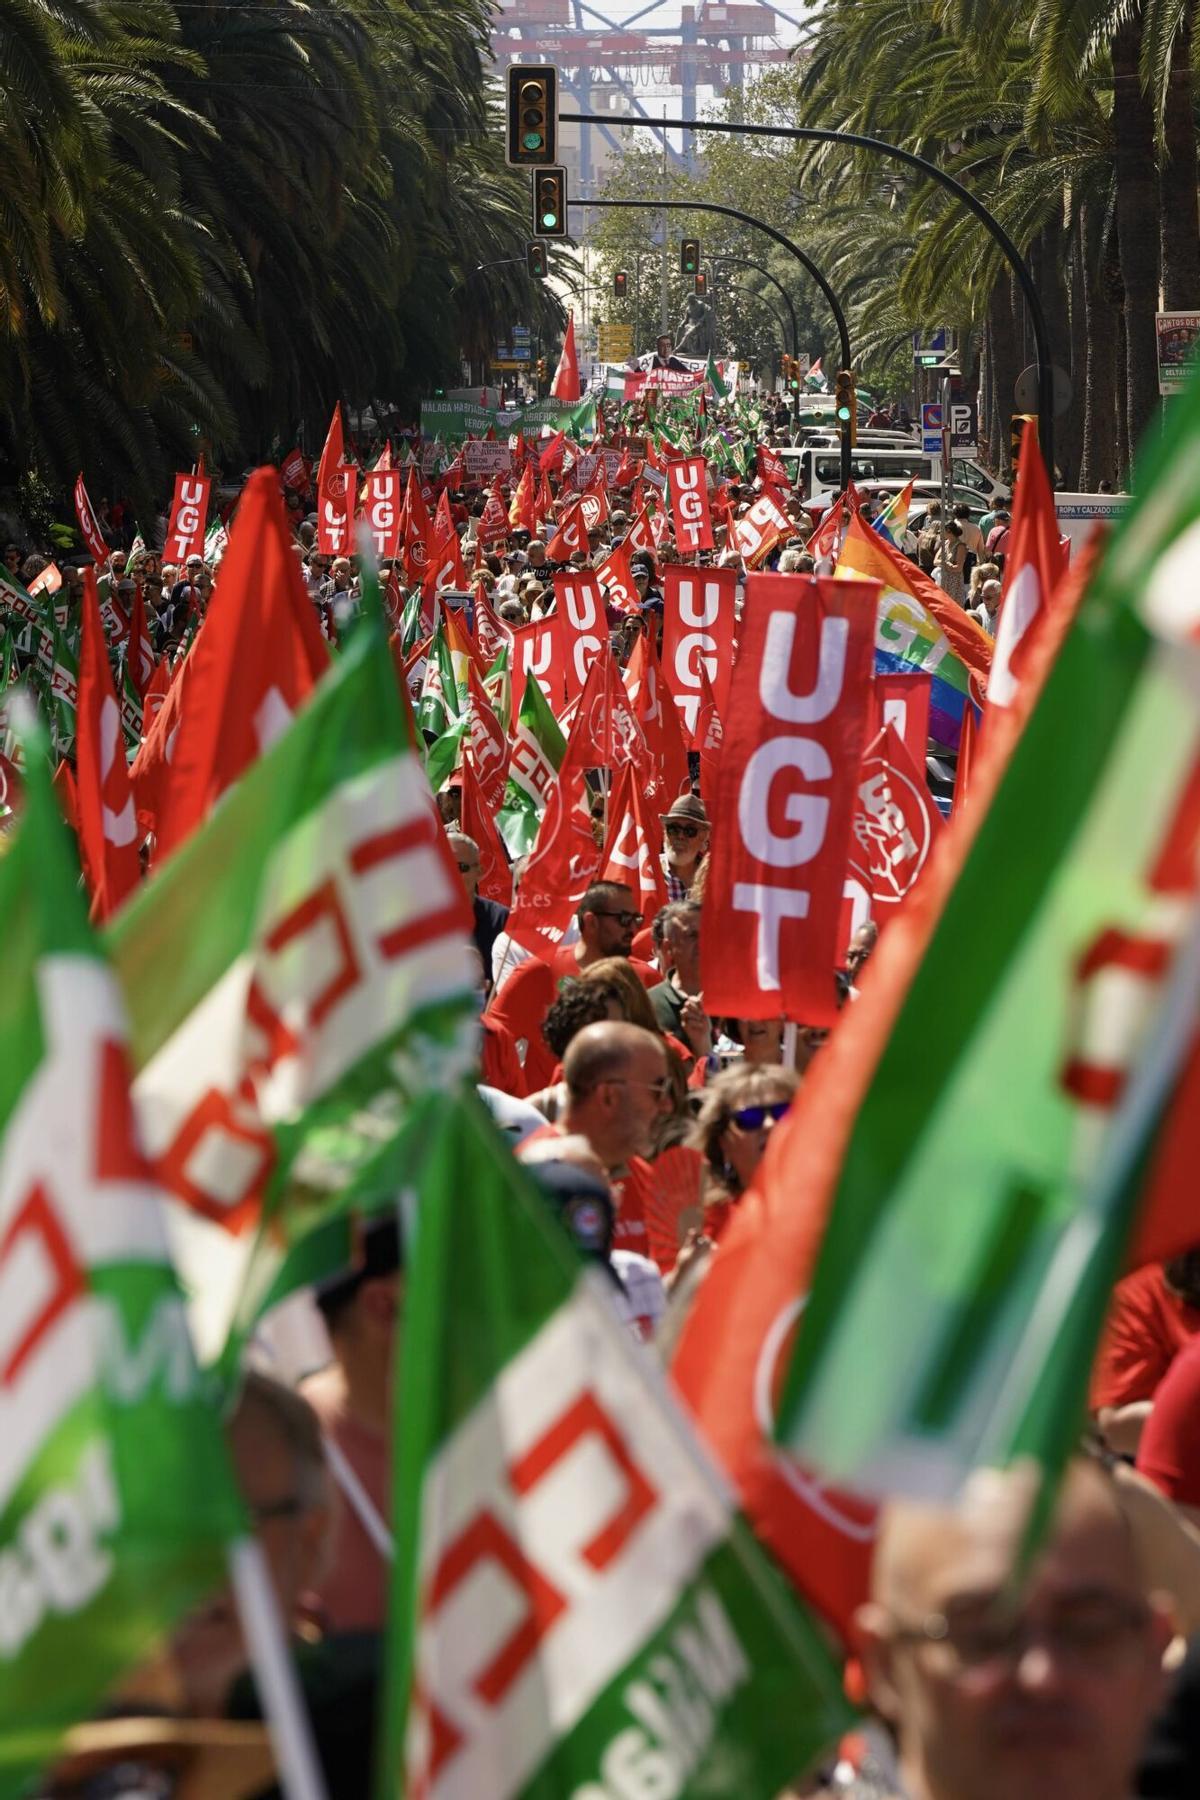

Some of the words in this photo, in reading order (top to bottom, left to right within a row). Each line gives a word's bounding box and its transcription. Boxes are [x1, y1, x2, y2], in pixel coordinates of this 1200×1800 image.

[174, 481, 203, 559] UGT
[372, 477, 394, 553] UGT
[675, 466, 704, 546] UGT
[1060, 506, 1076, 514] ROPA
[1081, 506, 1111, 514] CALZADO
[733, 610, 850, 991] UGT
